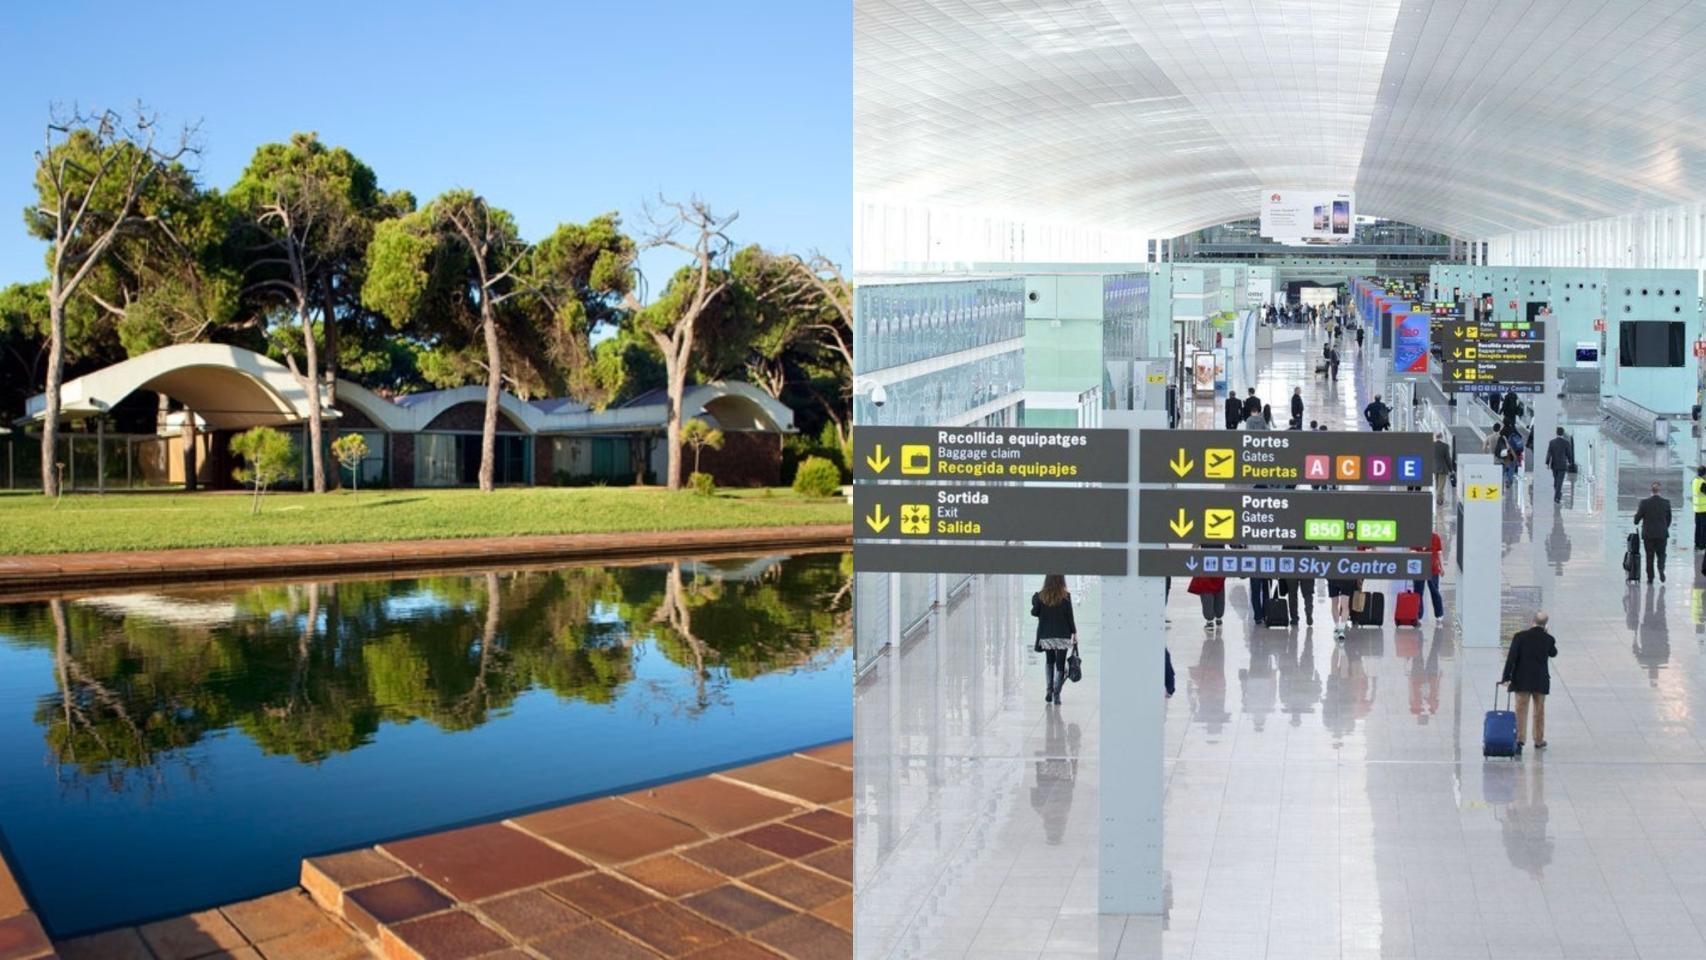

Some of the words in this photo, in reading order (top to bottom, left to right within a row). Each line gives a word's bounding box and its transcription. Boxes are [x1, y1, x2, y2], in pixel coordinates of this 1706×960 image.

[938, 431, 1004, 445] Recollida
[1008, 432, 1088, 448] equipatges
[1242, 434, 1290, 449] Portes
[938, 446, 988, 460] Baggage
[991, 447, 1021, 459] claim
[1242, 450, 1275, 462] Gates
[938, 461, 1005, 476] Recogida
[1009, 462, 1078, 477] equipajes
[1242, 464, 1298, 478] Puertas
[1310, 459, 1324, 476] A
[1341, 459, 1356, 476] C
[1372, 460, 1387, 476] D
[1404, 460, 1416, 476] E
[937, 490, 990, 504] Sortida
[1242, 495, 1289, 509] Portes
[937, 506, 959, 518] Exit
[1242, 511, 1275, 523] Gates
[937, 520, 982, 534] Salida
[1242, 525, 1297, 539] Puertas
[1309, 522, 1341, 538] B50
[1346, 521, 1355, 530] to
[1360, 523, 1393, 538] B24
[1346, 531, 1355, 540] a
[1298, 557, 1331, 577] Sky
[1337, 558, 1398, 575] Centre
